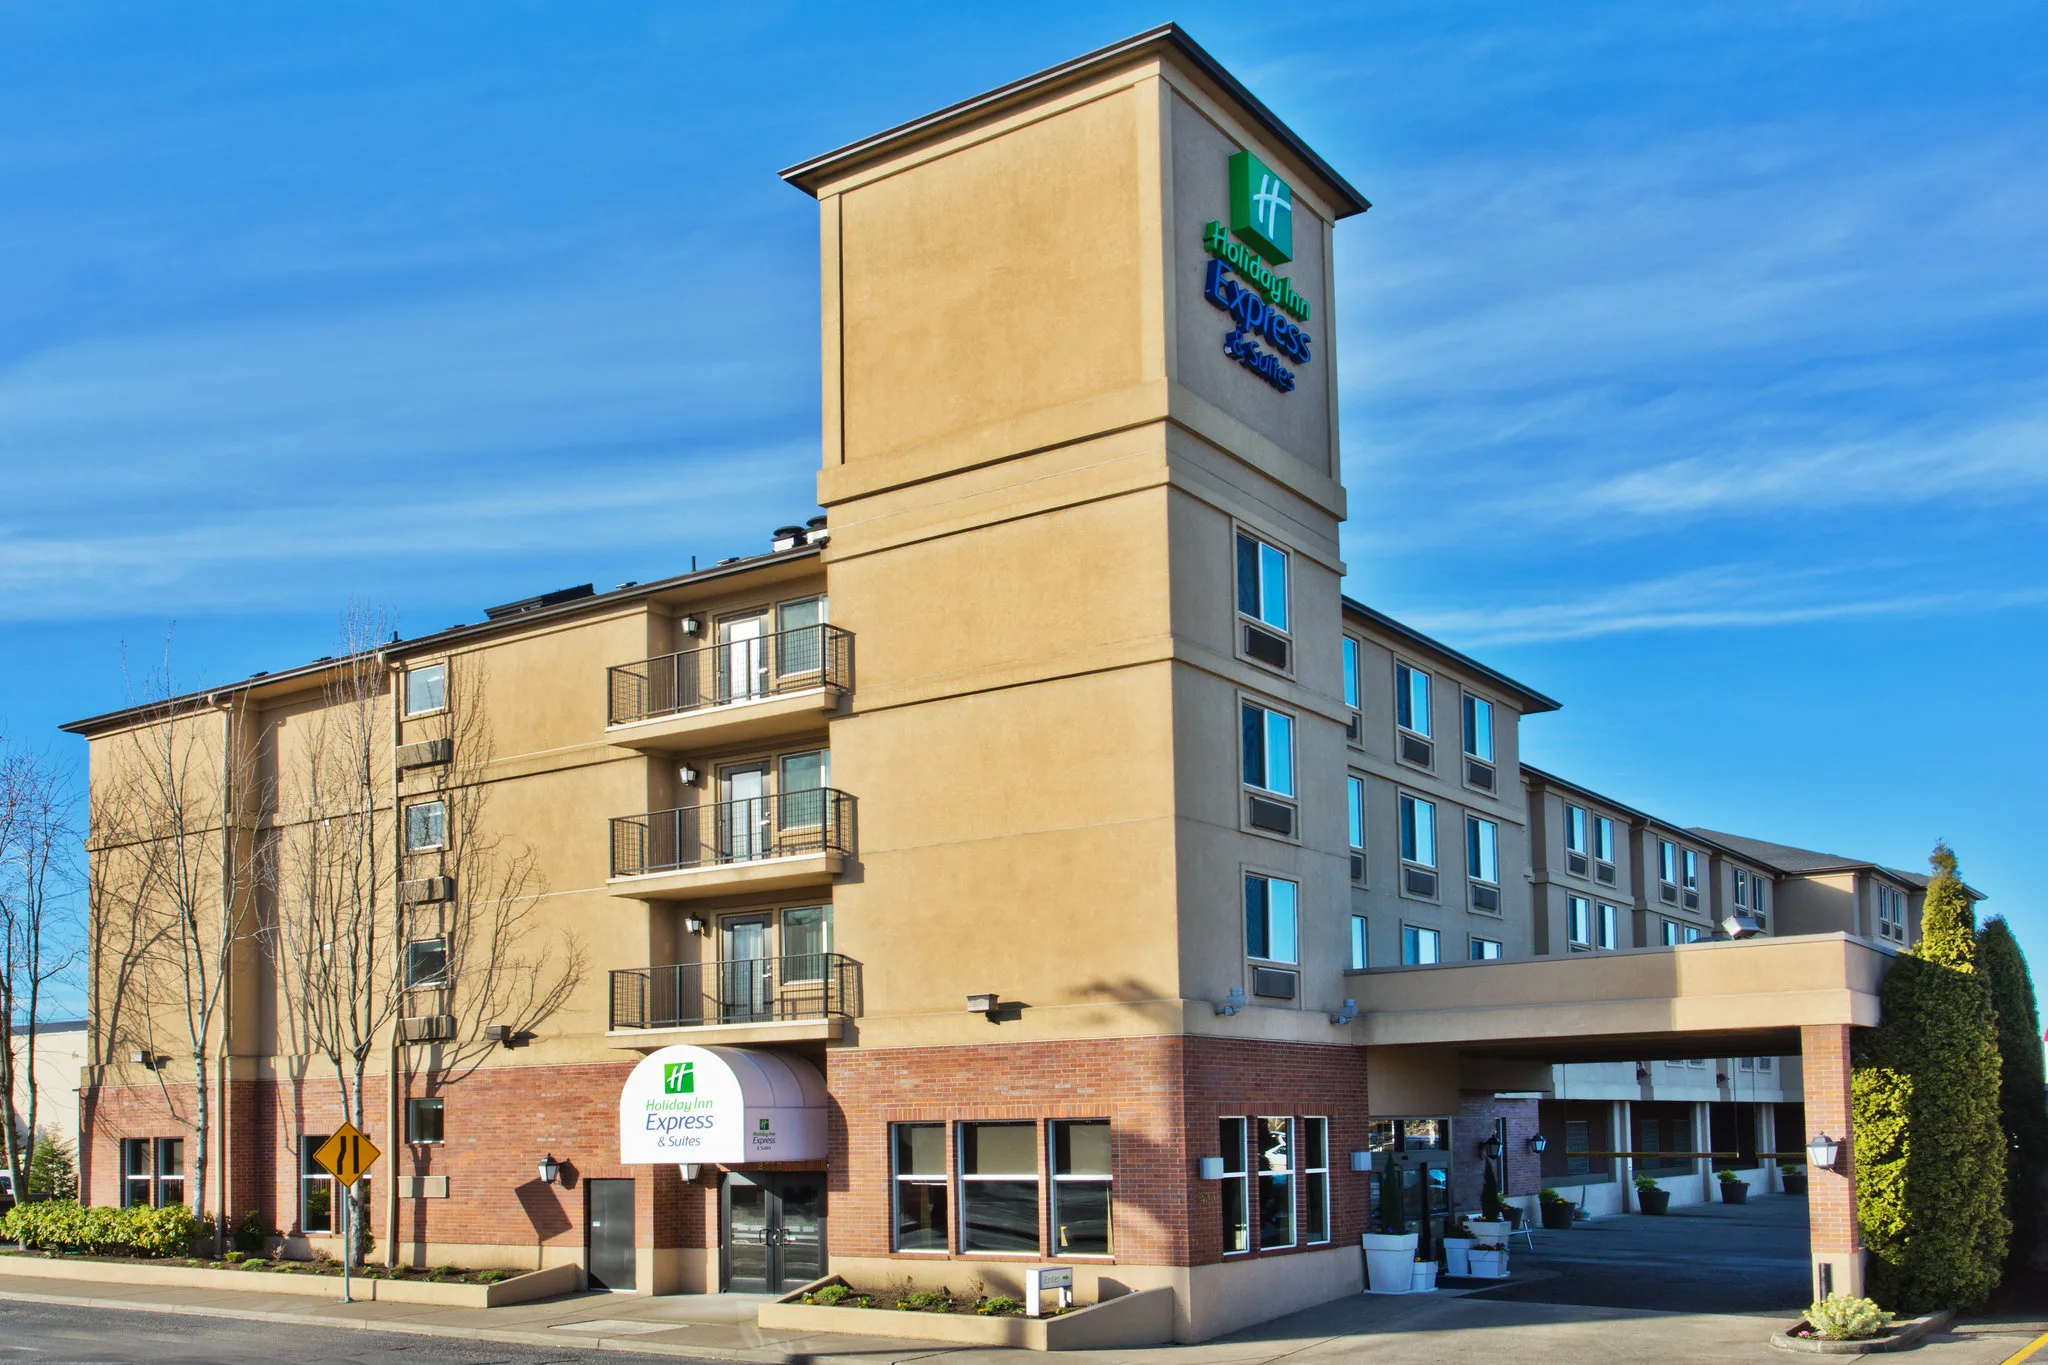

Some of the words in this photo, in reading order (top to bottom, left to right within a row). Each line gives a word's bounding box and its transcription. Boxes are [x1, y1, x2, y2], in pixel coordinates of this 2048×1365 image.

[1207, 220, 1281, 303] Holiday
[1284, 276, 1311, 321] Inn
[1208, 258, 1312, 364] Express
[1247, 340, 1296, 393] Suites
[646, 1099, 692, 1112] Holiday
[693, 1096, 713, 1109] Inn
[646, 1113, 714, 1134] Express
[657, 1136, 666, 1147] &
[668, 1135, 701, 1147] Suites
[752, 1137, 776, 1145] Express
[1043, 1275, 1061, 1284] Enter
